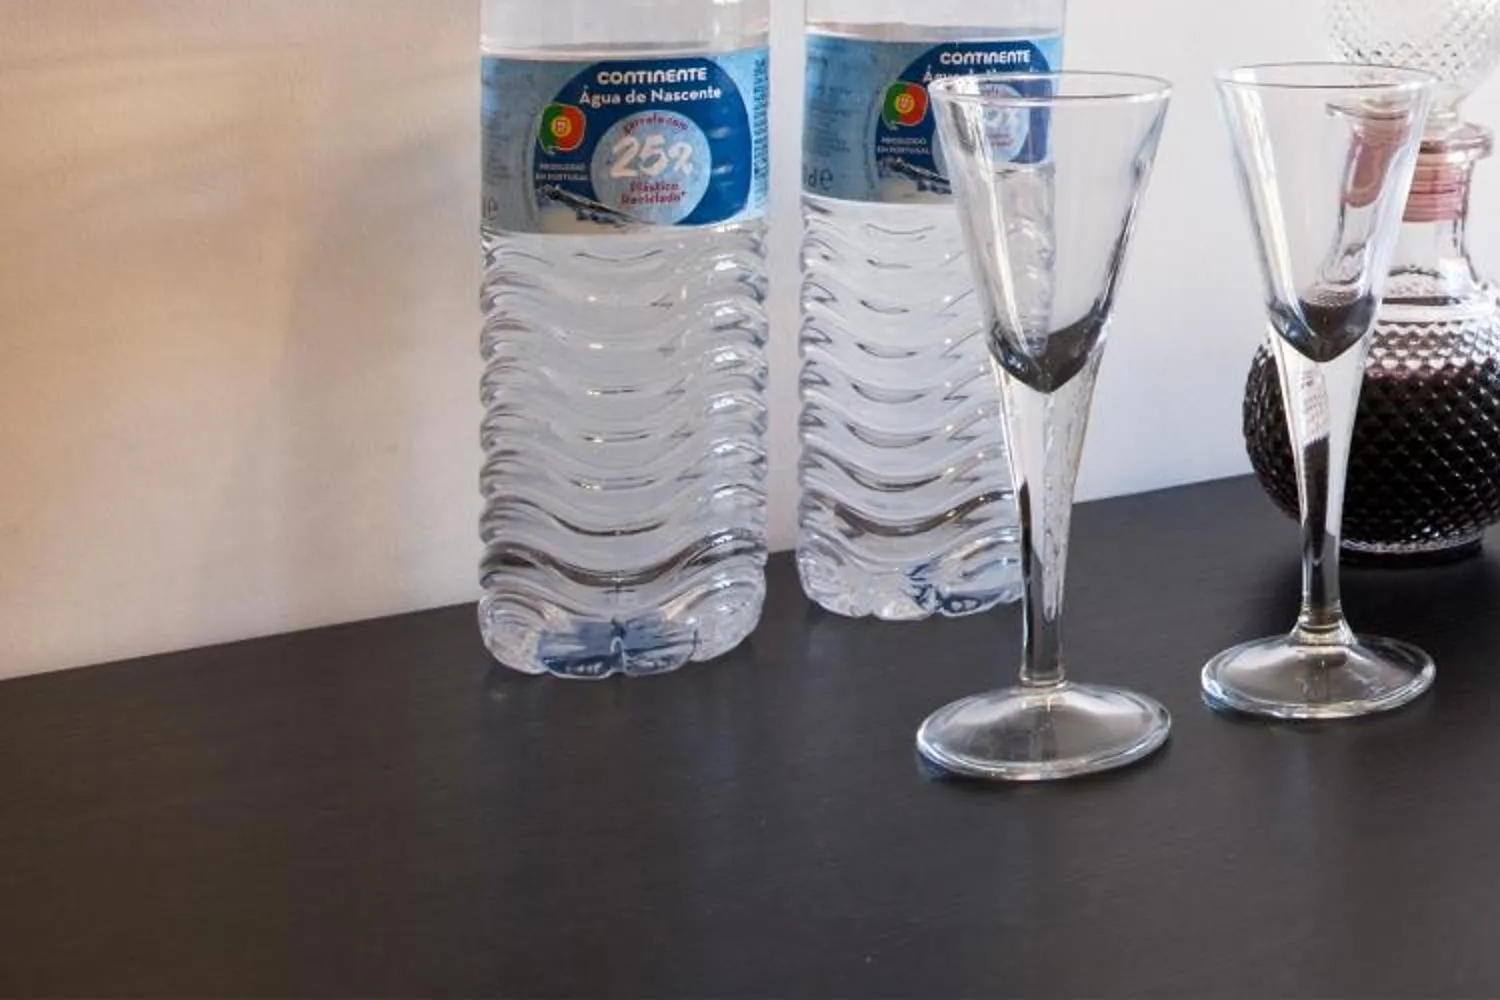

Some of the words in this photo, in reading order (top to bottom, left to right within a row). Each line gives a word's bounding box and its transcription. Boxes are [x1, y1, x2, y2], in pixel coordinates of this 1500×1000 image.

[596, 66, 707, 85] CONTINENTE
[579, 84, 621, 108] Água
[625, 89, 647, 104] de
[651, 85, 722, 103] Nascente
